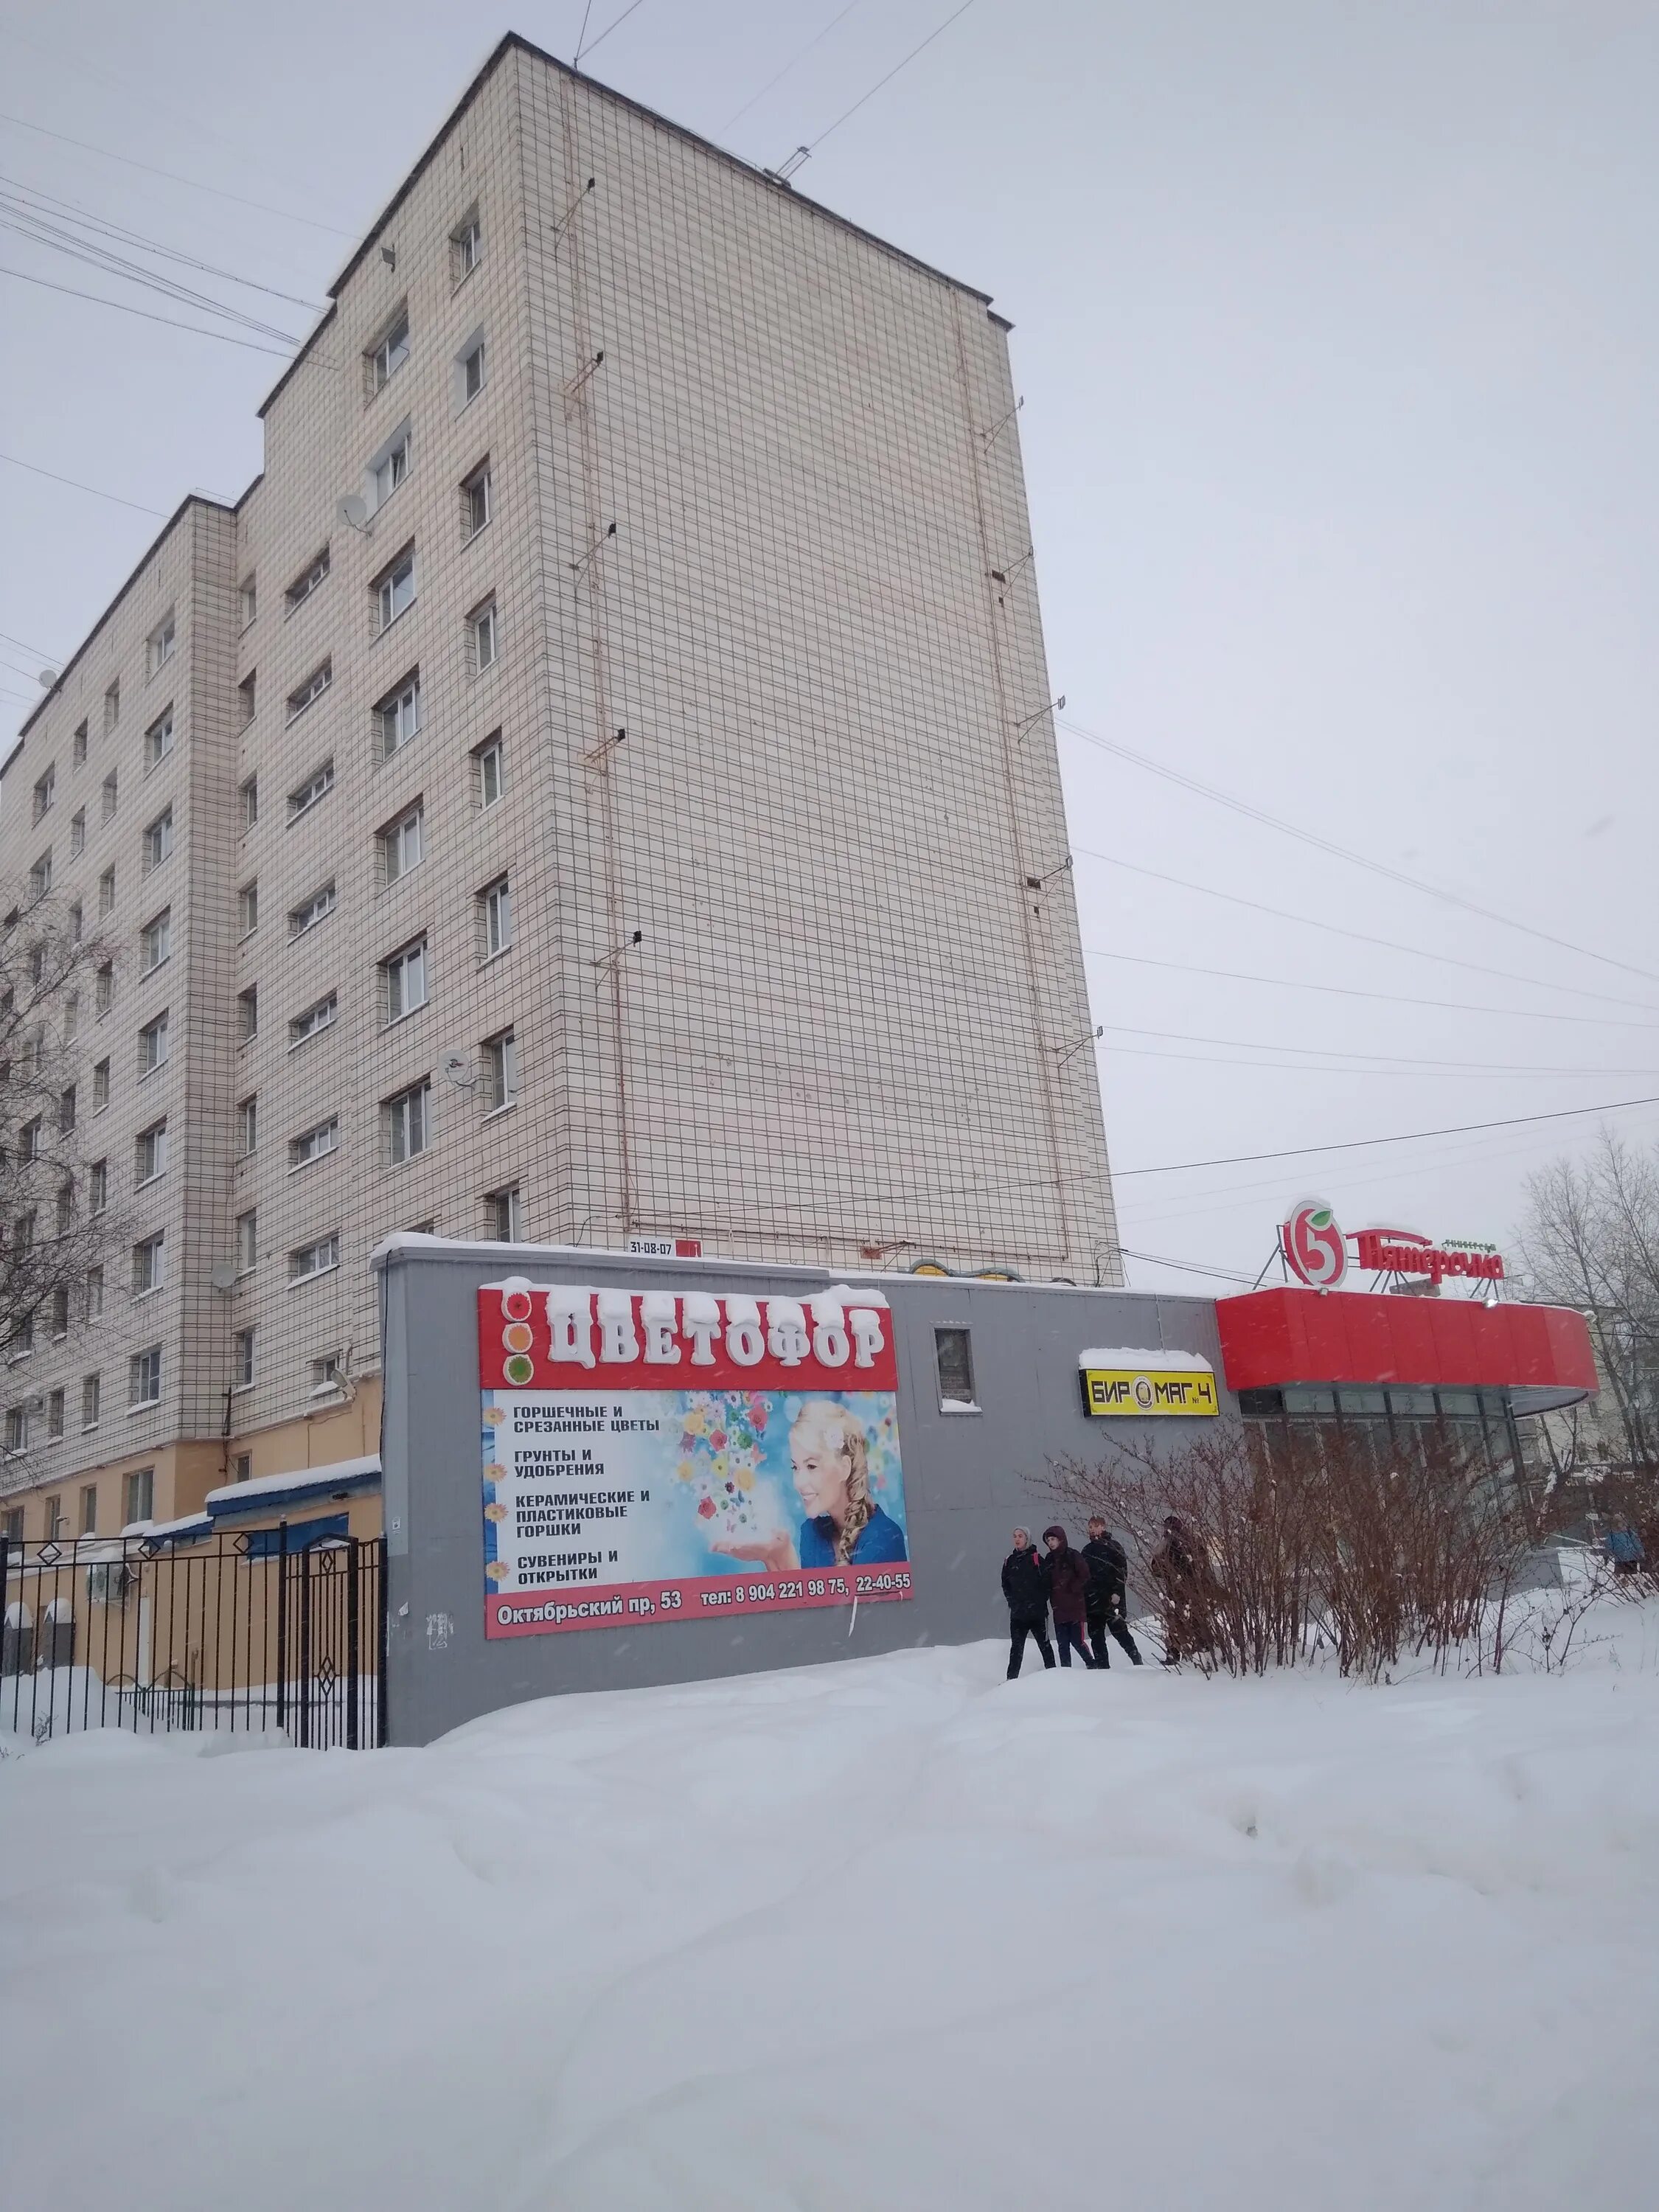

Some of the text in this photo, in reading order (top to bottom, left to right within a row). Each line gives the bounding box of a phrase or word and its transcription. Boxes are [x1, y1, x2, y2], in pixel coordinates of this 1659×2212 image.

[630, 1242, 672, 1255] 31-08-07
[546, 1295, 885, 1369] ЦВЕТОФОР
[513, 1406, 622, 1418] ГОРШЕЧНЫЕ И
[514, 1419, 659, 1433] СРЕЗАННЫЕ ЦВЕТЫ
[515, 1449, 591, 1462] ГРУНТЫ И
[515, 1463, 605, 1478] УДОБРЕНИЯ
[515, 1490, 650, 1508] КЕРАМИЧЕСКИЕ И
[516, 1506, 627, 1523] ПЛАСТИКОВЫЕ
[517, 1523, 581, 1538] ГОРШКИ
[518, 1550, 618, 1569] СУВЕНИРЫ И
[518, 1568, 598, 1585] ОТКРЫТКИ
[497, 1572, 911, 1625] Октябрьский пр, 53 тел: 8 904 221 98 75, 22-40-55
